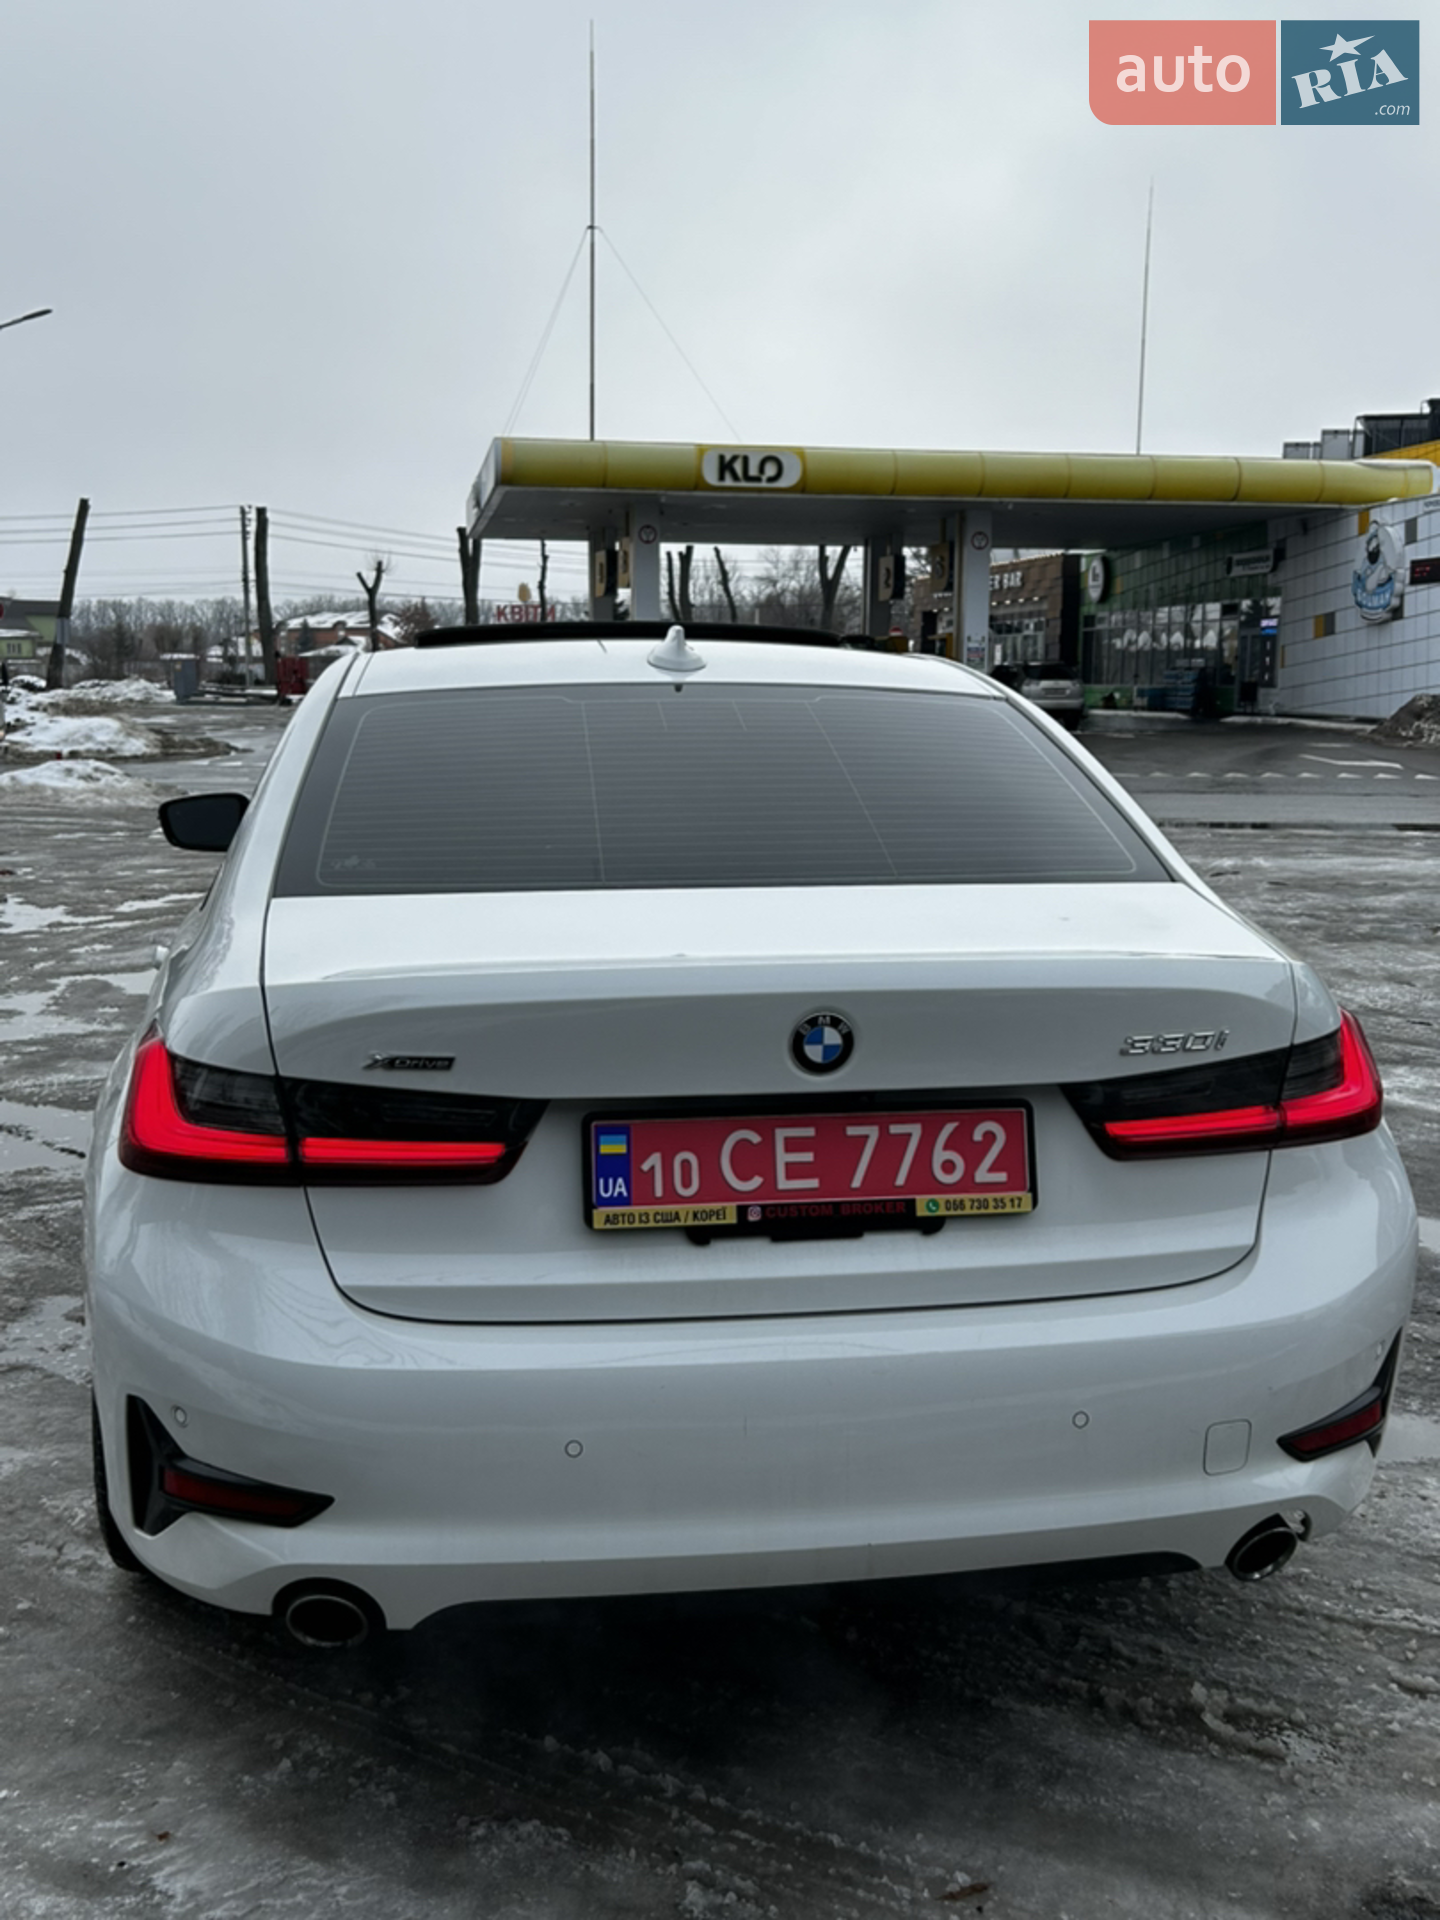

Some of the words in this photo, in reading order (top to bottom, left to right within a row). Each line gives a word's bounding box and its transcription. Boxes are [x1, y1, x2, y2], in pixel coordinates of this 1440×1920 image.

[717, 453, 785, 484] KLO
[988, 573, 1000, 591] ER
[798, 1016, 850, 1035] BMW
[1119, 1029, 1230, 1056] 330i
[639, 1150, 700, 1198] 10
[719, 1126, 819, 1192] CE
[845, 1120, 1008, 1189] 7762
[599, 1176, 628, 1198] UA
[945, 1200, 967, 1212] 066
[969, 1199, 989, 1211] 730
[991, 1198, 1007, 1210] 35
[1009, 1197, 1023, 1209] 17
[603, 1211, 636, 1226] АВТО
[638, 1211, 650, 1224] ІЗ
[653, 1210, 681, 1223] США
[692, 1207, 727, 1222] КОРЕЇ
